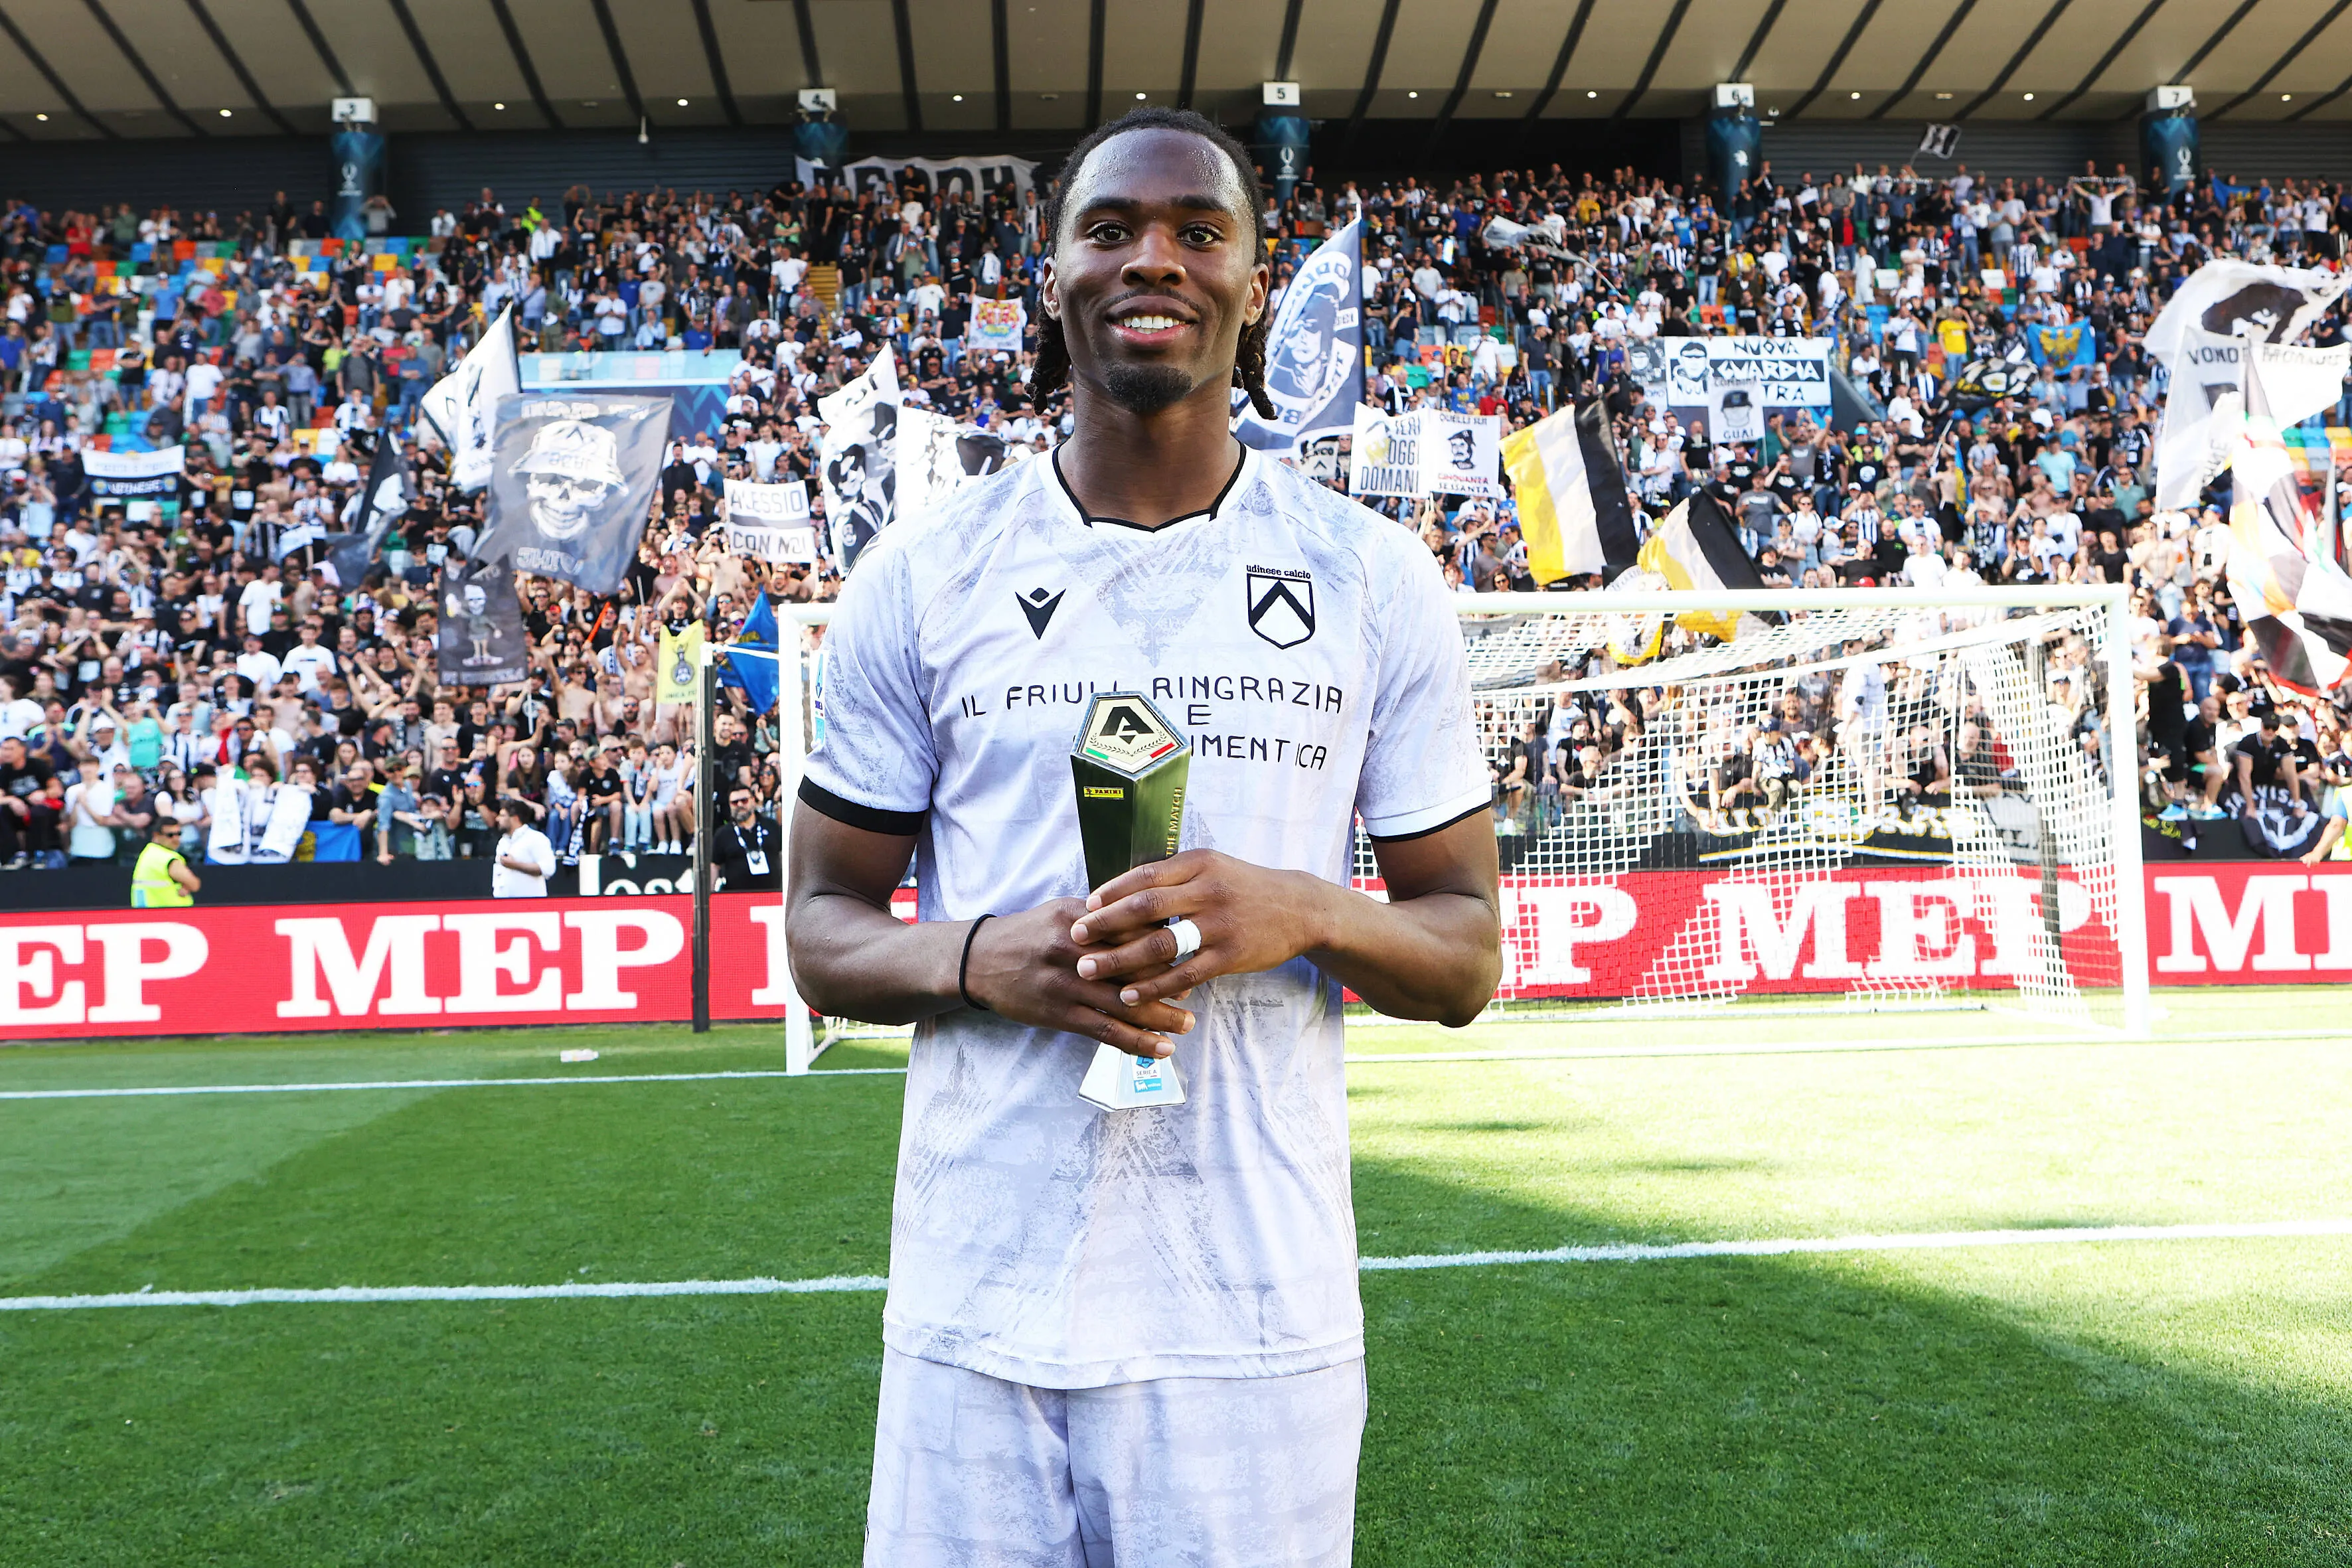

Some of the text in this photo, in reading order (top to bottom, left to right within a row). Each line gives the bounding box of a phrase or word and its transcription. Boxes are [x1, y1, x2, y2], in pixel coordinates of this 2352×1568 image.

[1277, 88, 1285, 100] 5
[2172, 92, 2179, 102] 7
[1734, 339, 1800, 356] NUOVA
[1717, 359, 1821, 380] GUARDIA
[1761, 384, 1806, 401] TRA
[1395, 415, 1420, 436] IERI
[1723, 428, 1754, 439] GUAI
[1388, 438, 1419, 465] OGGI
[1360, 466, 1419, 493] DOMANI
[730, 489, 803, 514] ALESSIO
[733, 531, 809, 556] CON NOI
[1246, 564, 1311, 580] udinese calcio
[962, 694, 986, 718] IL
[1152, 676, 1342, 714] RINGRAZIA
[1188, 704, 1212, 726] E
[1190, 734, 1327, 771] IMENTICA
[1165, 787, 1183, 857] THE MATCH
[1701, 878, 2092, 980] MEP
[275, 909, 684, 1018] MEP
